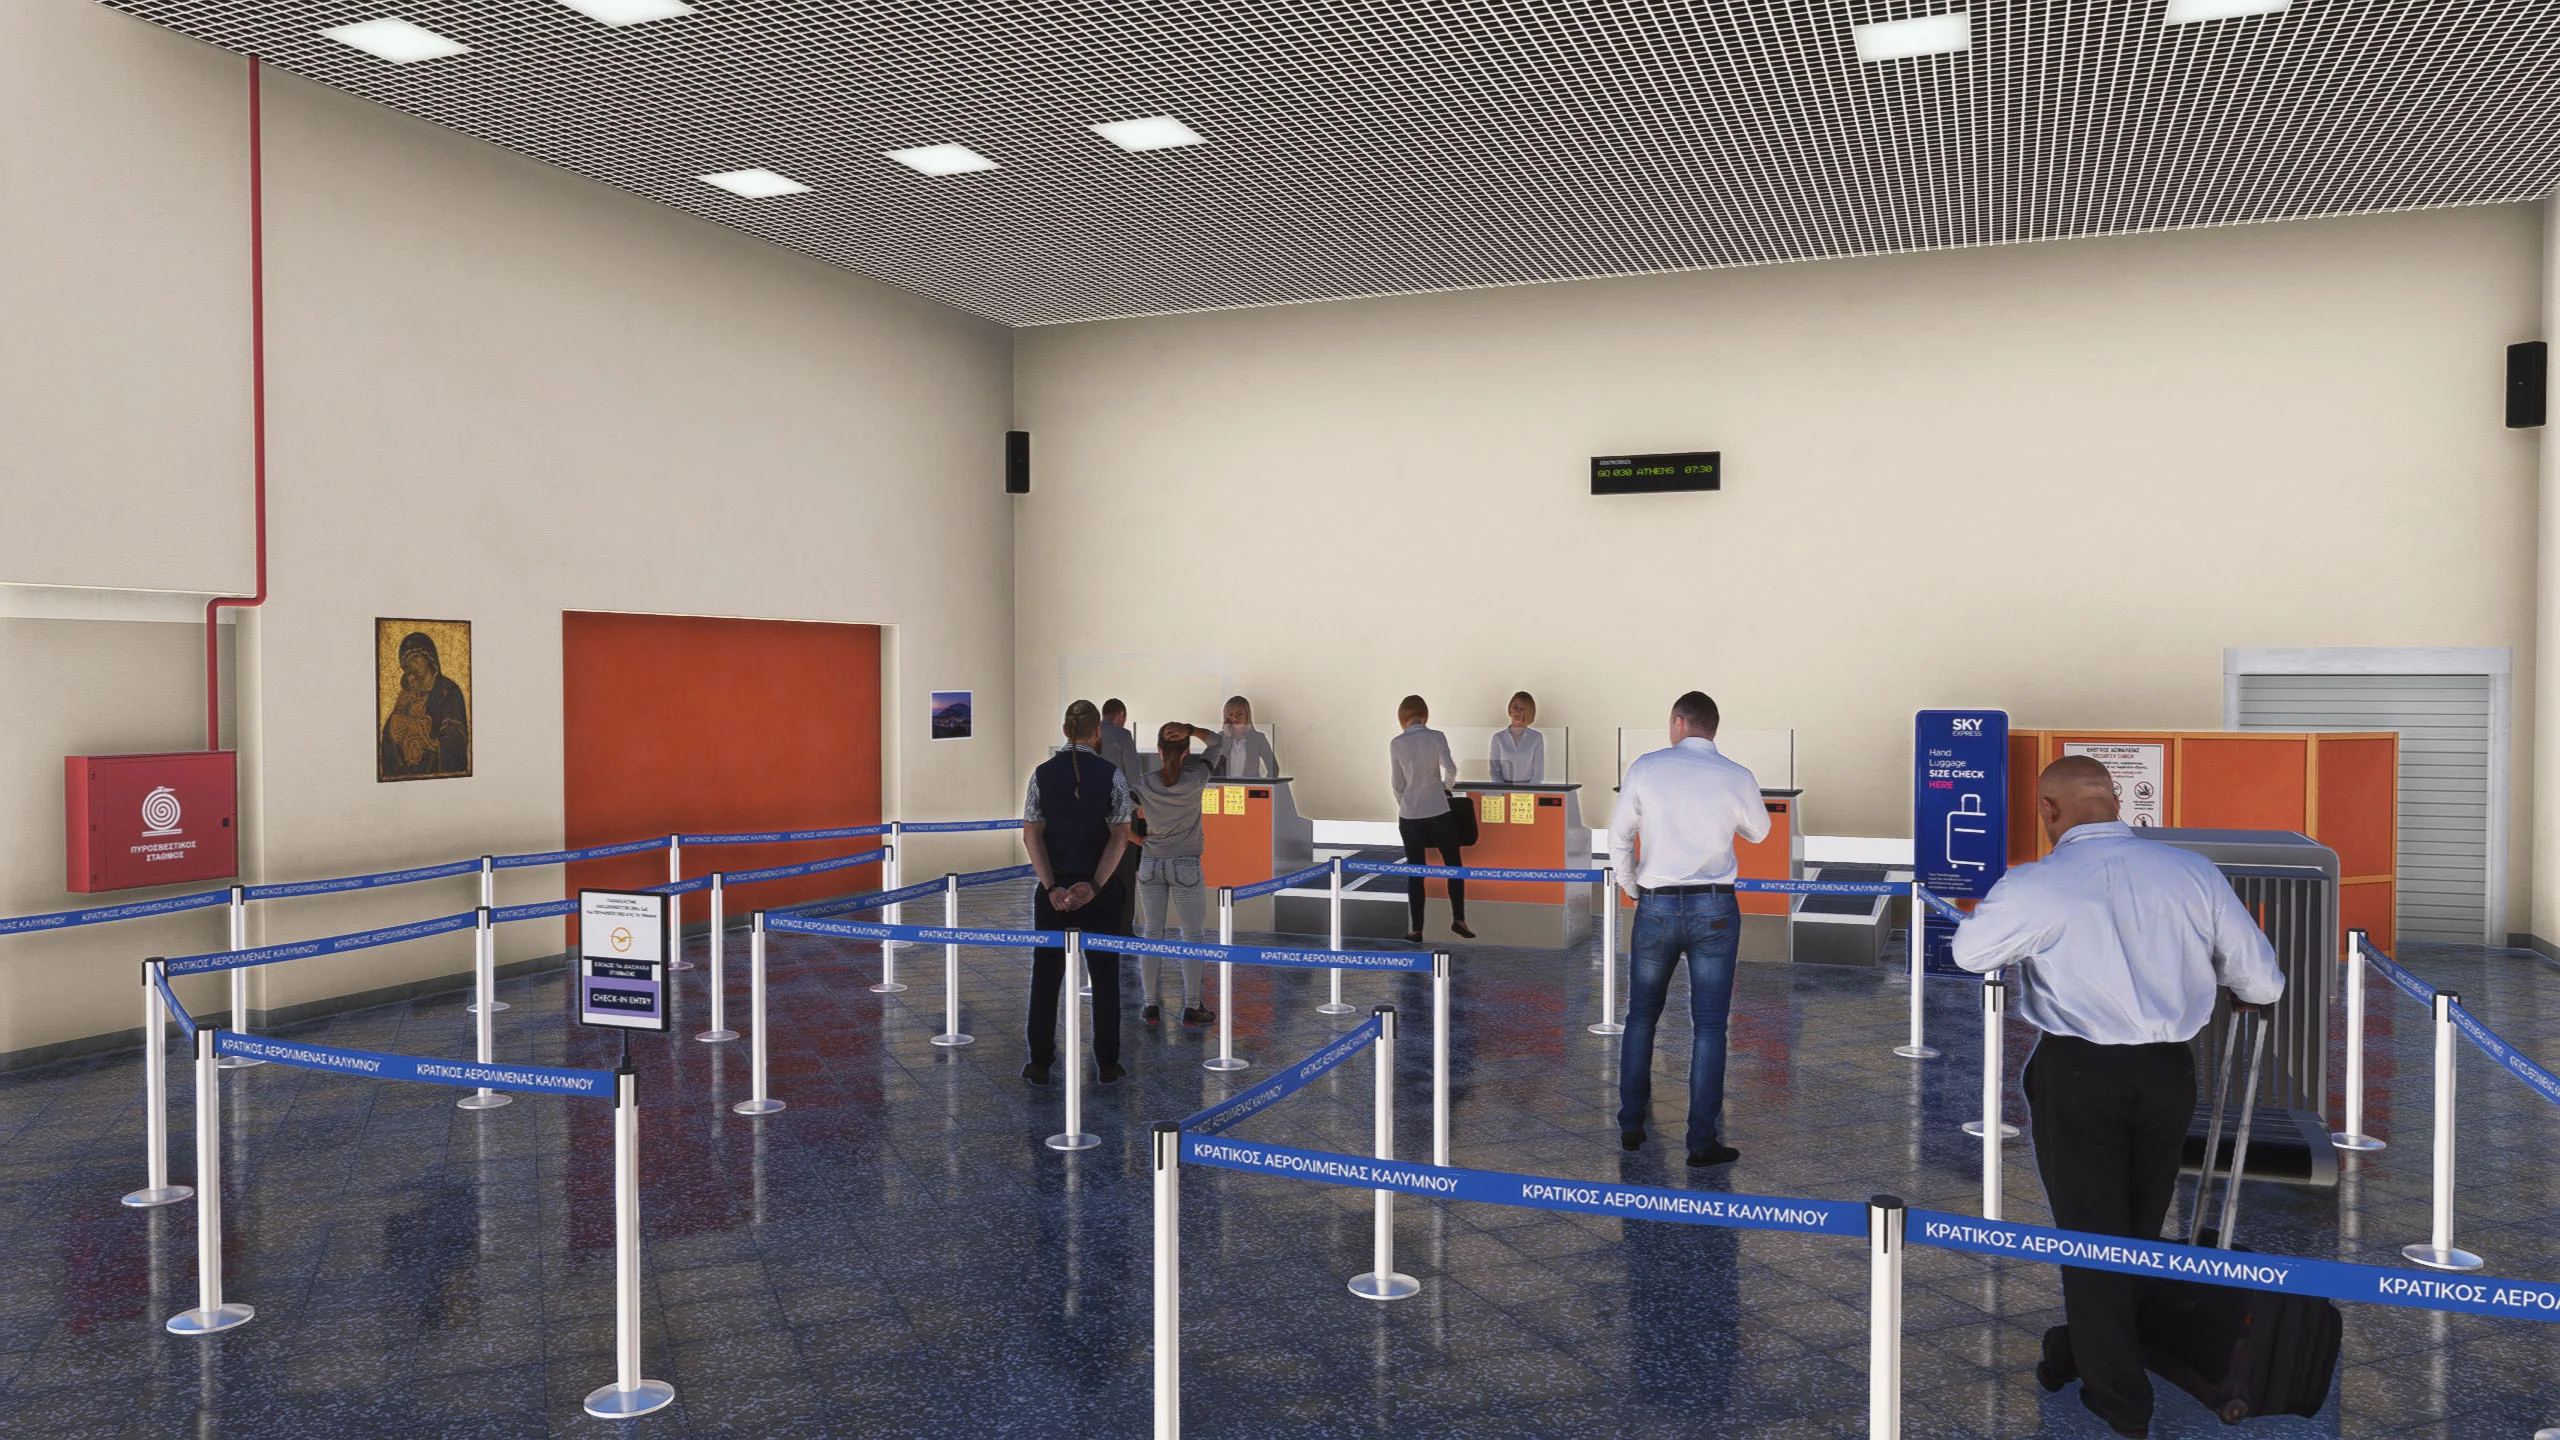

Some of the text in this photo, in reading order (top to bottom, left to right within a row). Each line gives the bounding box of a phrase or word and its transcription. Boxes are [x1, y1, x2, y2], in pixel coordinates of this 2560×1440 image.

[1636, 466, 1675, 476] ATHENS
[1684, 465, 1713, 473] 07:30
[1952, 718, 1983, 731] SKY
[1929, 749, 1952, 757] Hand
[1929, 759, 1967, 769] Luggage
[1929, 769, 1985, 779] SIZE CHECK
[1928, 780, 1954, 789] HERE
[130, 840, 197, 854] ΠΥΡΟΣΒΕΣΤΙΚΟΣ
[146, 851, 184, 862] ΣΤΑΘΜΟΣ
[1761, 882, 1893, 893] ΚΡΑΤΙΚΟΣ ΑΕΡΟΛΙΜΕΝΑΣ ΚΑΛΥΜΝΟΥ
[770, 918, 892, 938] ΚΡΑΤΙΚΟΣ ΑΕΡΟΛΙΜΕΝΑΣ ΚΑΛΥΜΝΟΥ
[918, 930, 1049, 945] ΚΡΑΤΙΚΟΣ ΑΕΡΟΛΙΜΕΝΑΣ ΚΑΛΥΜΝΟΥ
[211, 950, 273, 969] ΑΕΡΟΛΙΜΕΝΑΣ
[273, 943, 320, 958] ΚΑΛΥΜΝΟΥ
[1087, 937, 1229, 960] ΚΡΑΤΙΚΟΣ ΑΕΡΟΛΙΜΕΝΑΣ ΚΑΛΥΜΝΟΥ
[1260, 951, 1414, 968] ΚΡΑΤΙΚΟΣ ΑΕΡΟΛΙΜΕΝΑΣ ΚΑΛΥΜΝΟΥ
[592, 993, 652, 1005] CHECK-IN ENTRY
[222, 1038, 381, 1073] ΚΡΑΤΙΚΟΣ ΑΕΡΟΛΙΜΕΝΑΣ ΚΑΛΥΜΝΟΥ
[416, 1063, 594, 1091] ΚΡΑΤΙΚΟΣ ΑΕΡΟΛΙΜΕΝΑΣ ΚΑΛΥΜΝΟΥ
[1194, 1142, 1459, 1194] ΚΡΑΤΙΚΟΣ ΑΕΡΟΛΙΜΕΝΑΣ ΚΑΛΥΜΝΟΥ
[1522, 1183, 1829, 1227] ΚΡΑΤΙΚΟΣ ΑΕΡΟΛΙΜΕΝΑΣ ΚΑΛΥΜΝΟΥ
[1925, 1221, 2290, 1286] ΚΡΑΤΙΚΟΣ ΑΕΡΟΛΙΜΕΝΑΣ ΚΑΛΥΜΝΟΥ
[2378, 1276, 2488, 1304] ΚΡΑΤΙΚΟΣ
